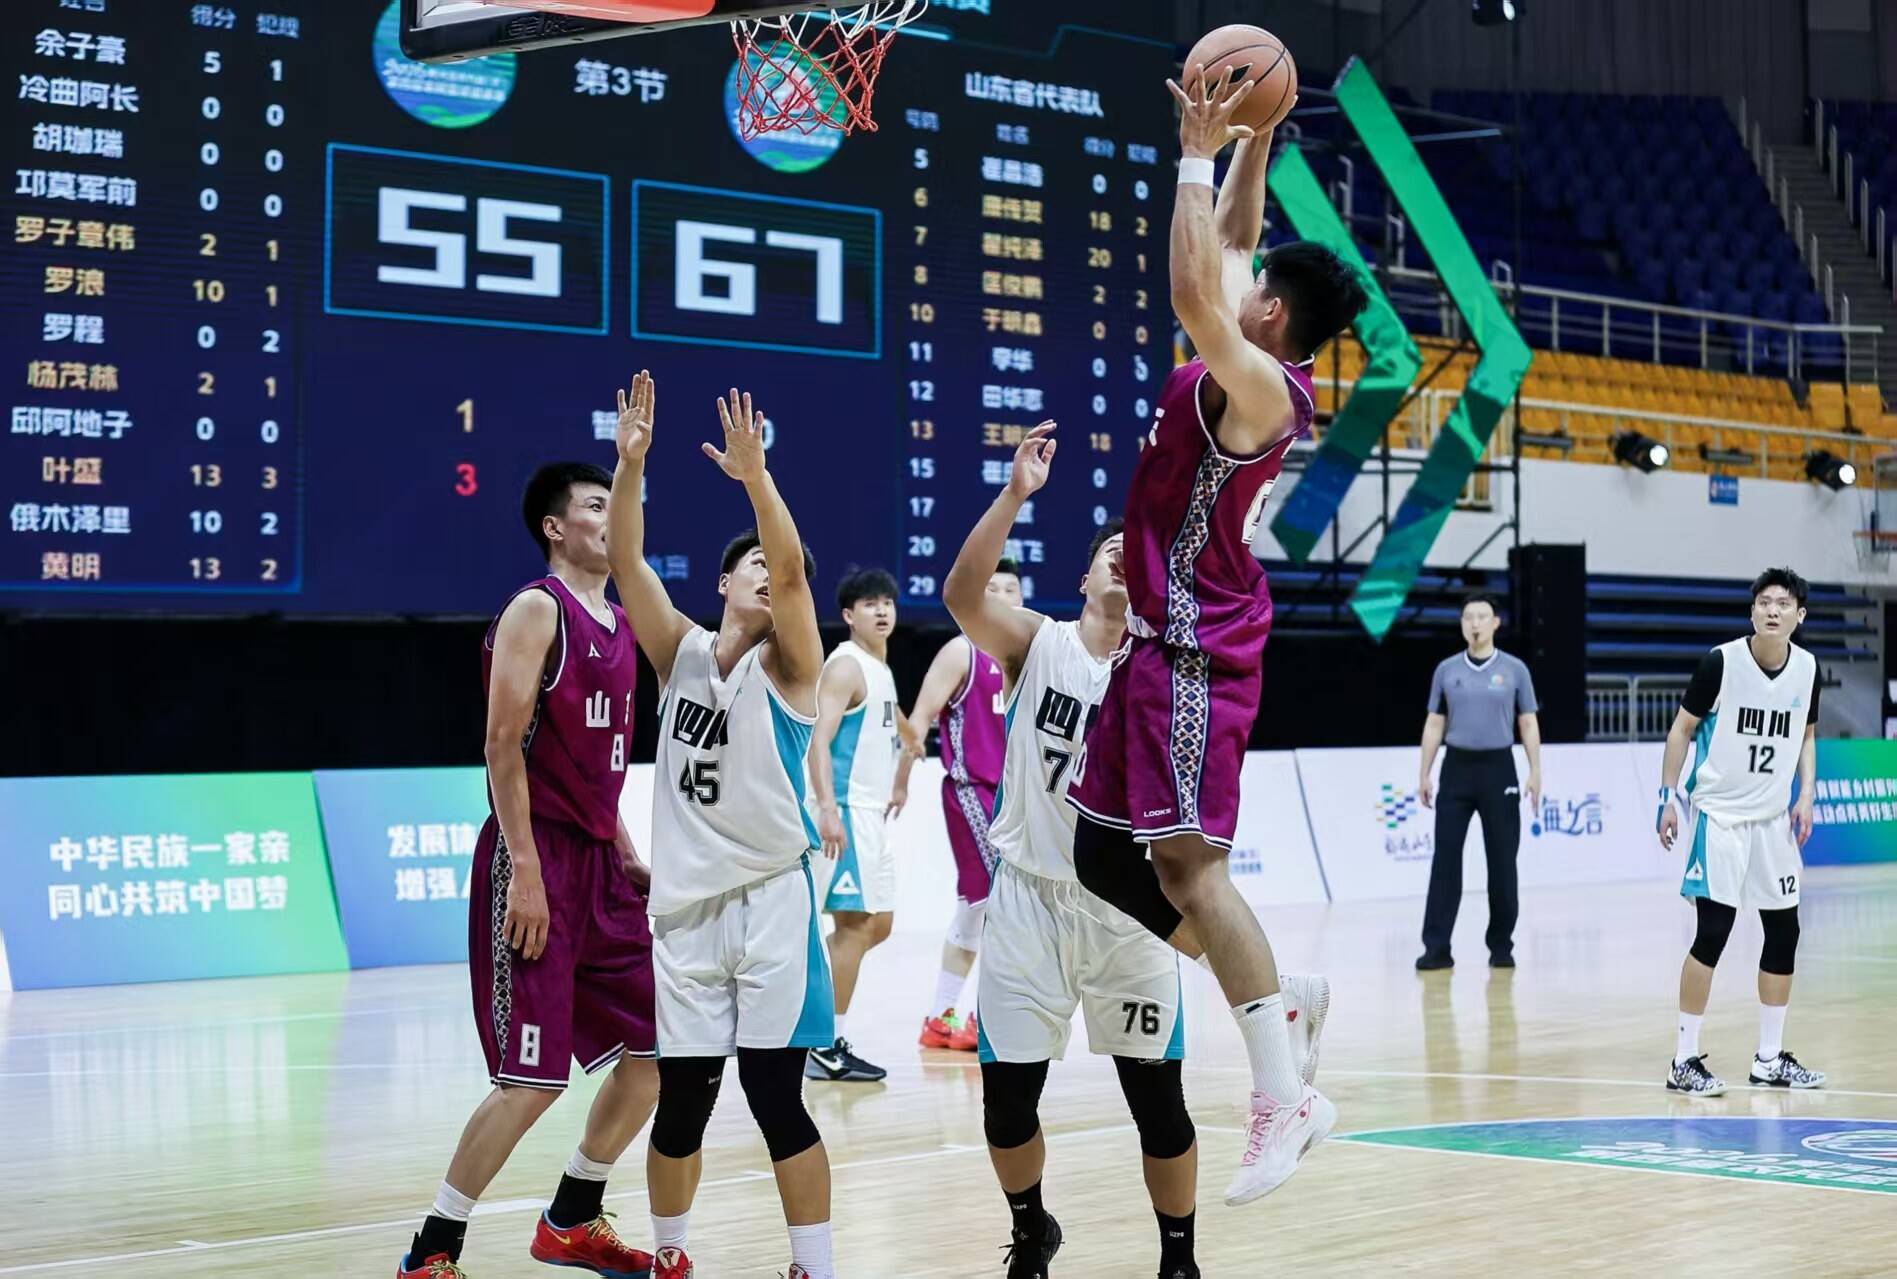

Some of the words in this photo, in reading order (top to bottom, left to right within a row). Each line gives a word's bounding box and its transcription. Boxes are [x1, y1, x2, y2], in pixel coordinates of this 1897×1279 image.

[35, 29, 125, 64] 余子豪
[204, 51, 220, 73] 5
[271, 60, 282, 81] 1
[575, 59, 667, 102] 第3节
[966, 72, 1103, 117] 山东省代表队
[19, 75, 138, 112] 冷曲阿长
[202, 97, 220, 119] 0
[267, 104, 284, 126] 0
[202, 143, 219, 164] 0
[265, 150, 283, 171] 0
[915, 149, 928, 168] 5
[1093, 174, 1106, 193] 0
[1135, 181, 1148, 199] 0
[200, 189, 218, 210] 0
[265, 195, 282, 216] 0
[914, 188, 927, 207] 6
[1136, 217, 1147, 235] 2
[200, 234, 216, 256] 2
[267, 240, 277, 260] 1
[378, 187, 561, 297] 55
[915, 226, 927, 244] 7
[1089, 248, 1111, 267] 20
[1138, 254, 1145, 271] 1
[45, 267, 104, 295] 罗浪
[194, 280, 224, 302] 10
[267, 286, 277, 306] 1
[676, 220, 842, 324] 67
[915, 266, 927, 284] 8
[1094, 286, 1105, 304] 2
[1136, 290, 1147, 308] 2
[198, 326, 215, 348] 0
[263, 330, 279, 352] 2
[911, 304, 934, 322] 10
[1093, 322, 1105, 339] 0
[1136, 326, 1147, 343] 0
[910, 342, 931, 361] 11
[1093, 358, 1106, 377] 0
[198, 372, 214, 394] 2
[265, 377, 275, 397] 1
[910, 381, 933, 401] 12
[1093, 395, 1106, 414] 0
[1136, 399, 1148, 417] 0
[197, 417, 214, 440] 0
[261, 421, 278, 443] 0
[457, 399, 472, 432] 1
[911, 421, 933, 439] 13
[43, 457, 101, 484] 叶盛
[191, 465, 221, 486] 13
[262, 467, 277, 488] 3
[456, 464, 477, 496] 3
[910, 458, 934, 478] 15
[1094, 469, 1106, 487] 0
[190, 511, 221, 533] 10
[261, 512, 277, 534] 2
[910, 497, 934, 516] 17
[1094, 506, 1107, 525] 0
[909, 536, 935, 556] 20
[42, 552, 99, 579] 黄明
[190, 558, 220, 579] 13
[262, 559, 276, 579] 2
[910, 576, 934, 595] 29
[672, 697, 729, 750] 四川
[1736, 707, 1791, 738] 四川
[611, 734, 624, 771] 8
[1043, 746, 1075, 794] 7
[1748, 744, 1775, 774] 12
[679, 760, 721, 806] 45
[49, 830, 291, 873] 中华民族一家亲
[387, 823, 479, 858] 发展体
[48, 875, 288, 921] 同心共筑中国梦
[1779, 875, 1797, 896] 12
[1121, 1001, 1160, 1036] 76
[519, 1024, 540, 1066] 8
